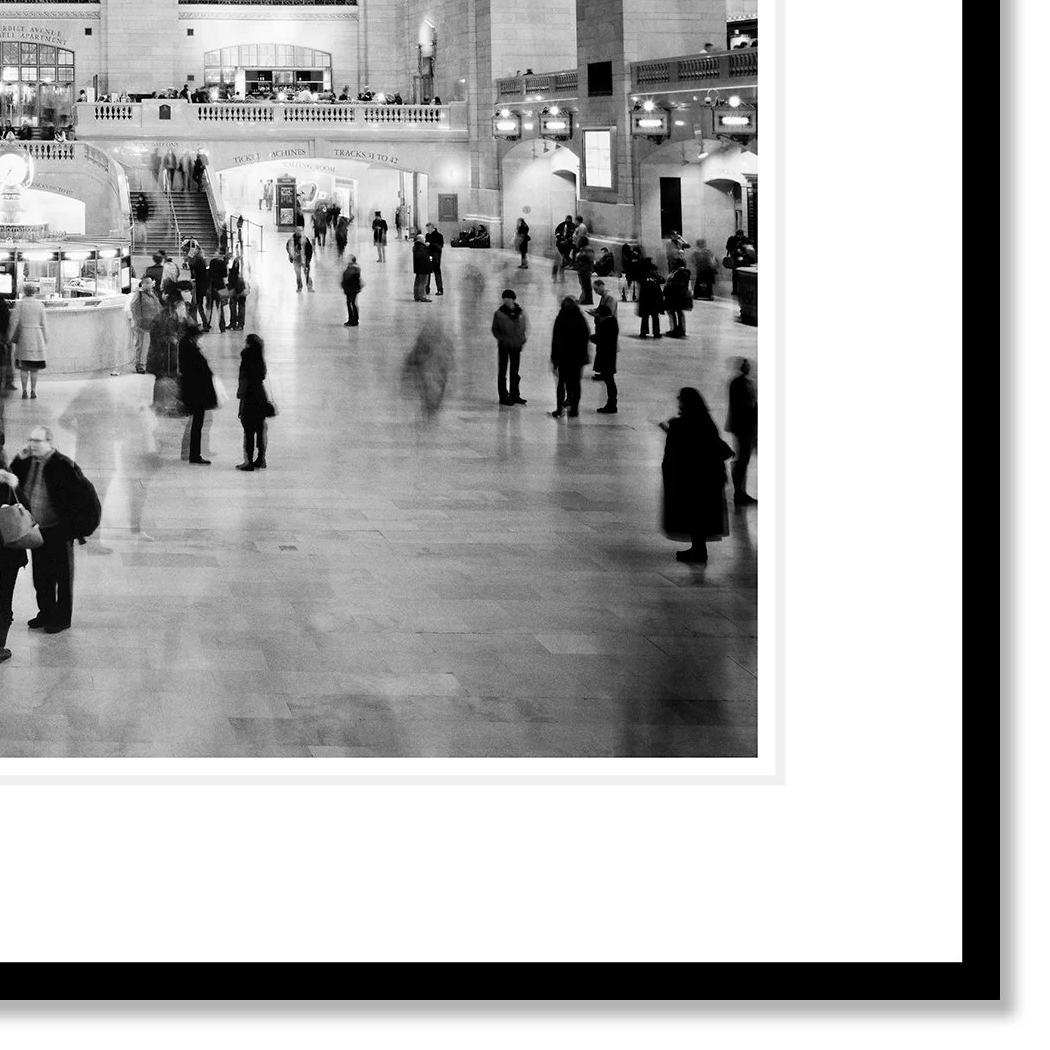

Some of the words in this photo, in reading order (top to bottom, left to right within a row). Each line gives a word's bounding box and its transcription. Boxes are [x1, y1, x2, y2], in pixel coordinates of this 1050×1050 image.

[30, 27, 62, 37] AVENUE
[20, 33, 68, 46] APARTMENT
[267, 148, 307, 158] ACHINES
[334, 149, 366, 159] TRACKS
[376, 153, 388, 162] TO
